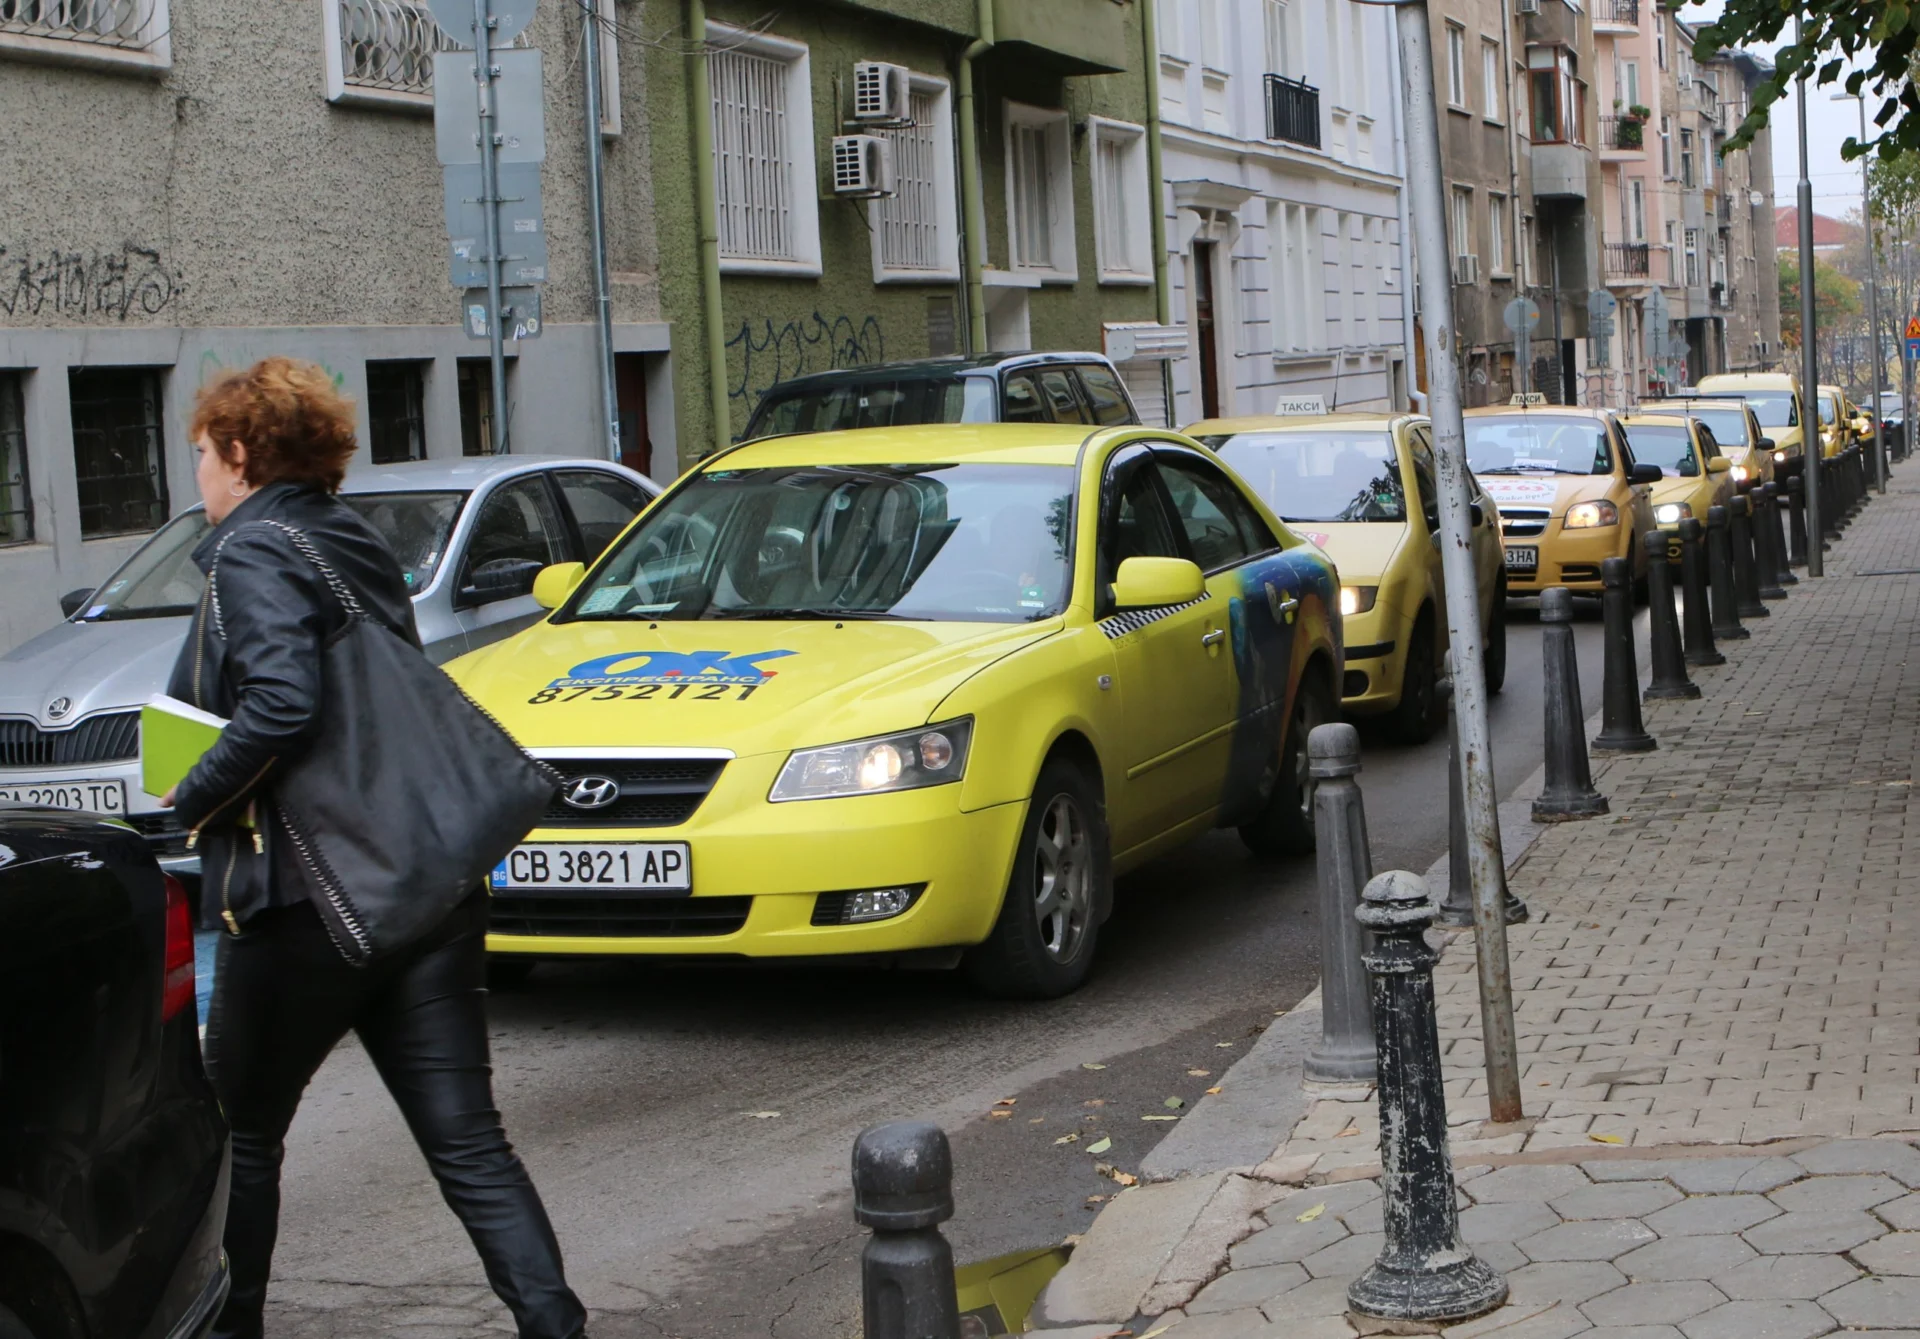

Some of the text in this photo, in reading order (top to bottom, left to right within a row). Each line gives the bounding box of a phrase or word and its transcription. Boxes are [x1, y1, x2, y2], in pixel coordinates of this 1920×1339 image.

[1281, 402, 1320, 412] ТАКСИ
[1514, 395, 1541, 404] ТАКСИ
[527, 684, 759, 705] 8752121
[88, 785, 118, 811] TC
[510, 850, 682, 883] CB 3821 AP
[493, 871, 506, 881] BG
